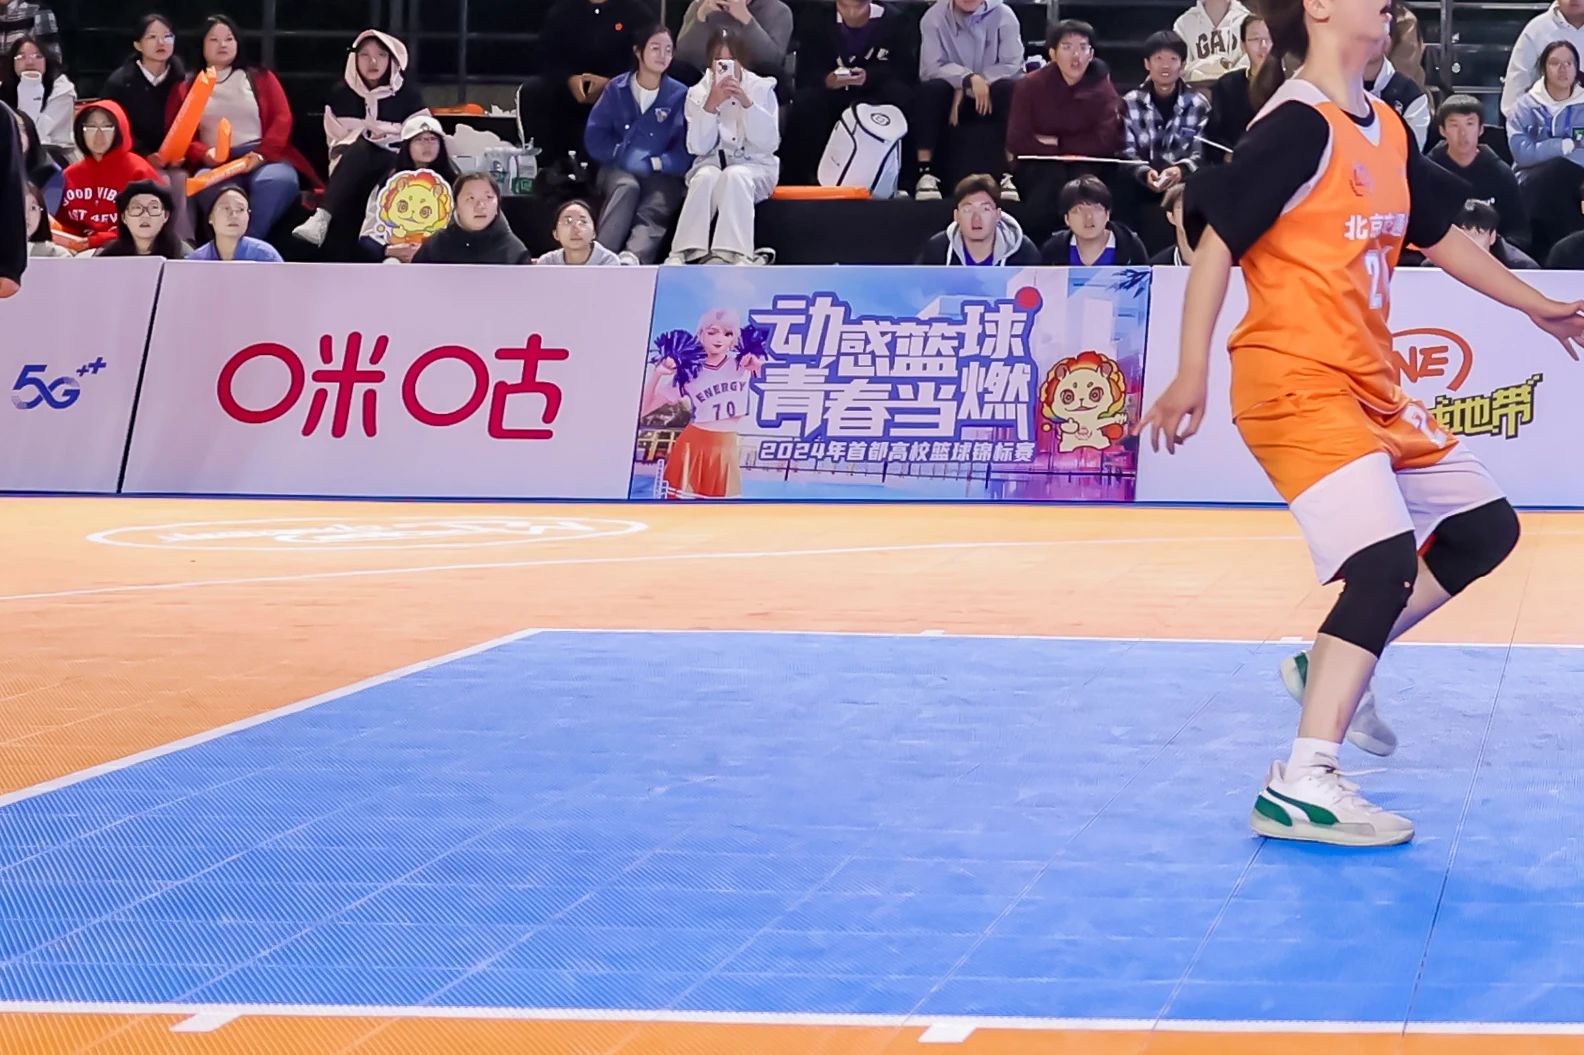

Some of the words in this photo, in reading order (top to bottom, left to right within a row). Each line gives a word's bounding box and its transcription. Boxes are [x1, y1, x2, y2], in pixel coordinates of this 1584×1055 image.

[752, 294, 1031, 378] 动感篮球
[217, 330, 570, 440] 咪咕
[695, 381, 747, 404] ENERGY
[712, 400, 737, 421] 70
[756, 360, 1032, 441] 青春当燃
[758, 440, 1036, 464] 2024年首都高校篮球锦标赛
